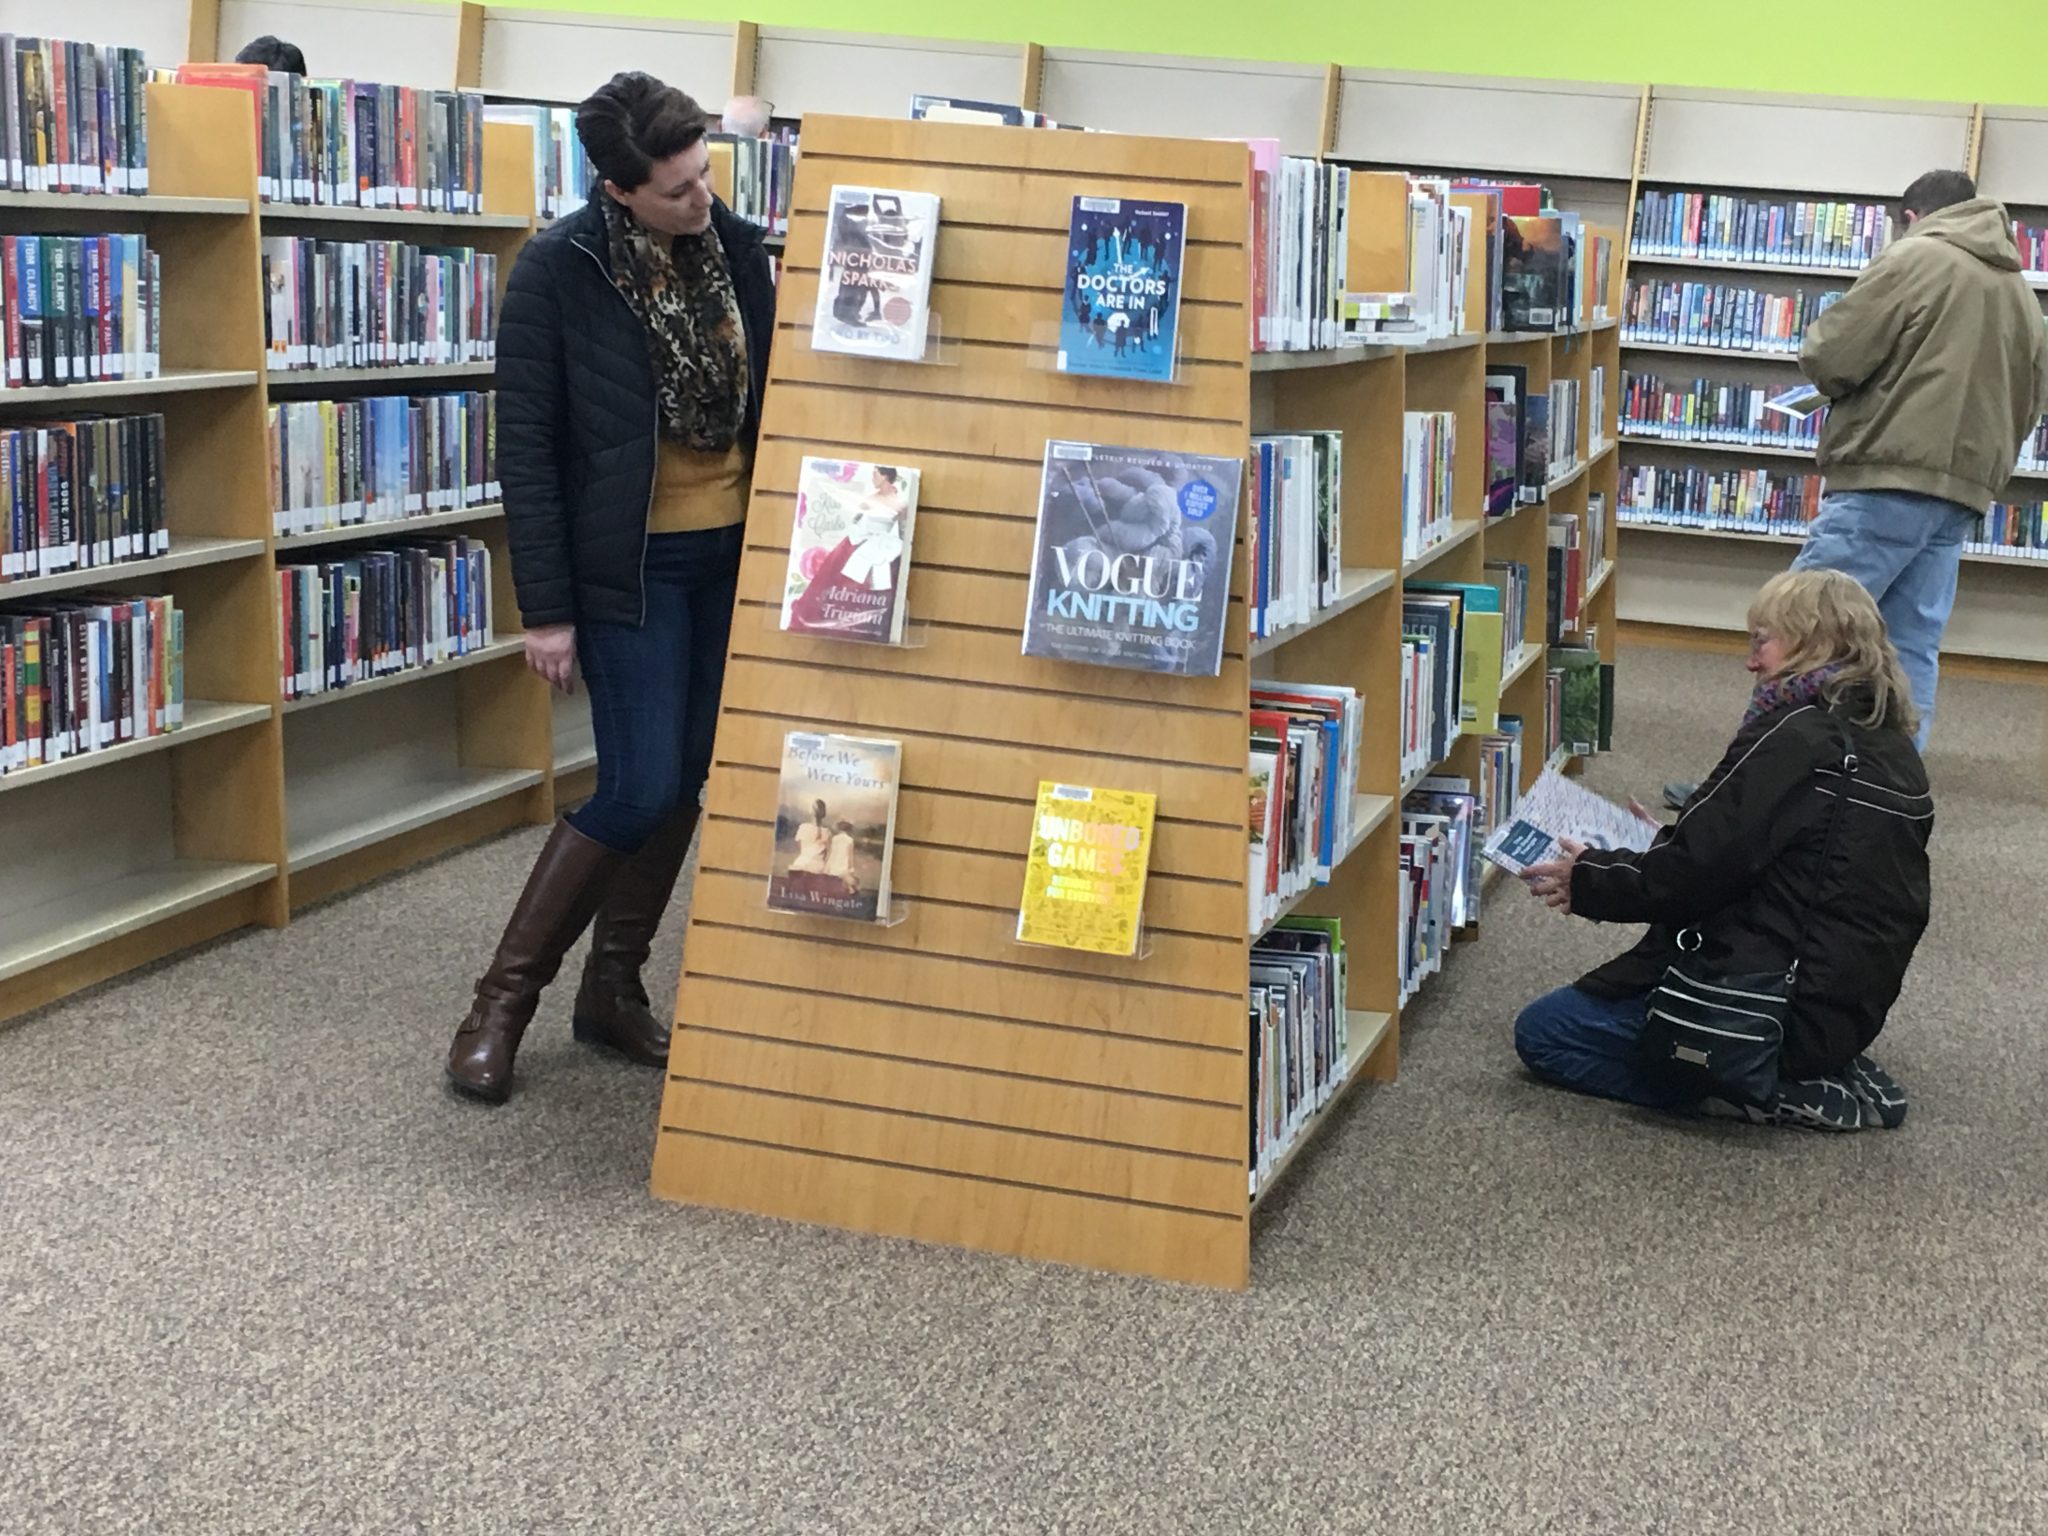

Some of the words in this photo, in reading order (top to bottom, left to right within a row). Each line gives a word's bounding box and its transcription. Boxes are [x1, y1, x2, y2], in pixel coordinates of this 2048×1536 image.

[25, 244, 36, 265] TOM
[55, 249, 65, 268] TOM
[91, 249, 99, 268] TOM
[828, 252, 916, 274] NICHOLAS
[1114, 263, 1133, 274] THE
[26, 269, 38, 310] CLANCY
[56, 272, 66, 311] CLANCY
[92, 273, 100, 310] CLANCY
[842, 271, 901, 292] SPARK
[1077, 275, 1166, 296] DOCTORS
[1096, 295, 1124, 309] ARE
[1128, 296, 1145, 309] IN
[62, 518, 71, 544] AGAI
[1050, 546, 1204, 602] VOGUE
[1046, 589, 1200, 632] KNITTING
[79, 624, 88, 650] CITY
[1045, 624, 1065, 635] THE
[1066, 626, 1112, 640] ULTIMATE
[1115, 631, 1163, 644] KNITTING
[838, 751, 860, 766] We
[808, 767, 841, 784] Were
[846, 772, 885, 789] Yours
[810, 892, 862, 909] Wingate
